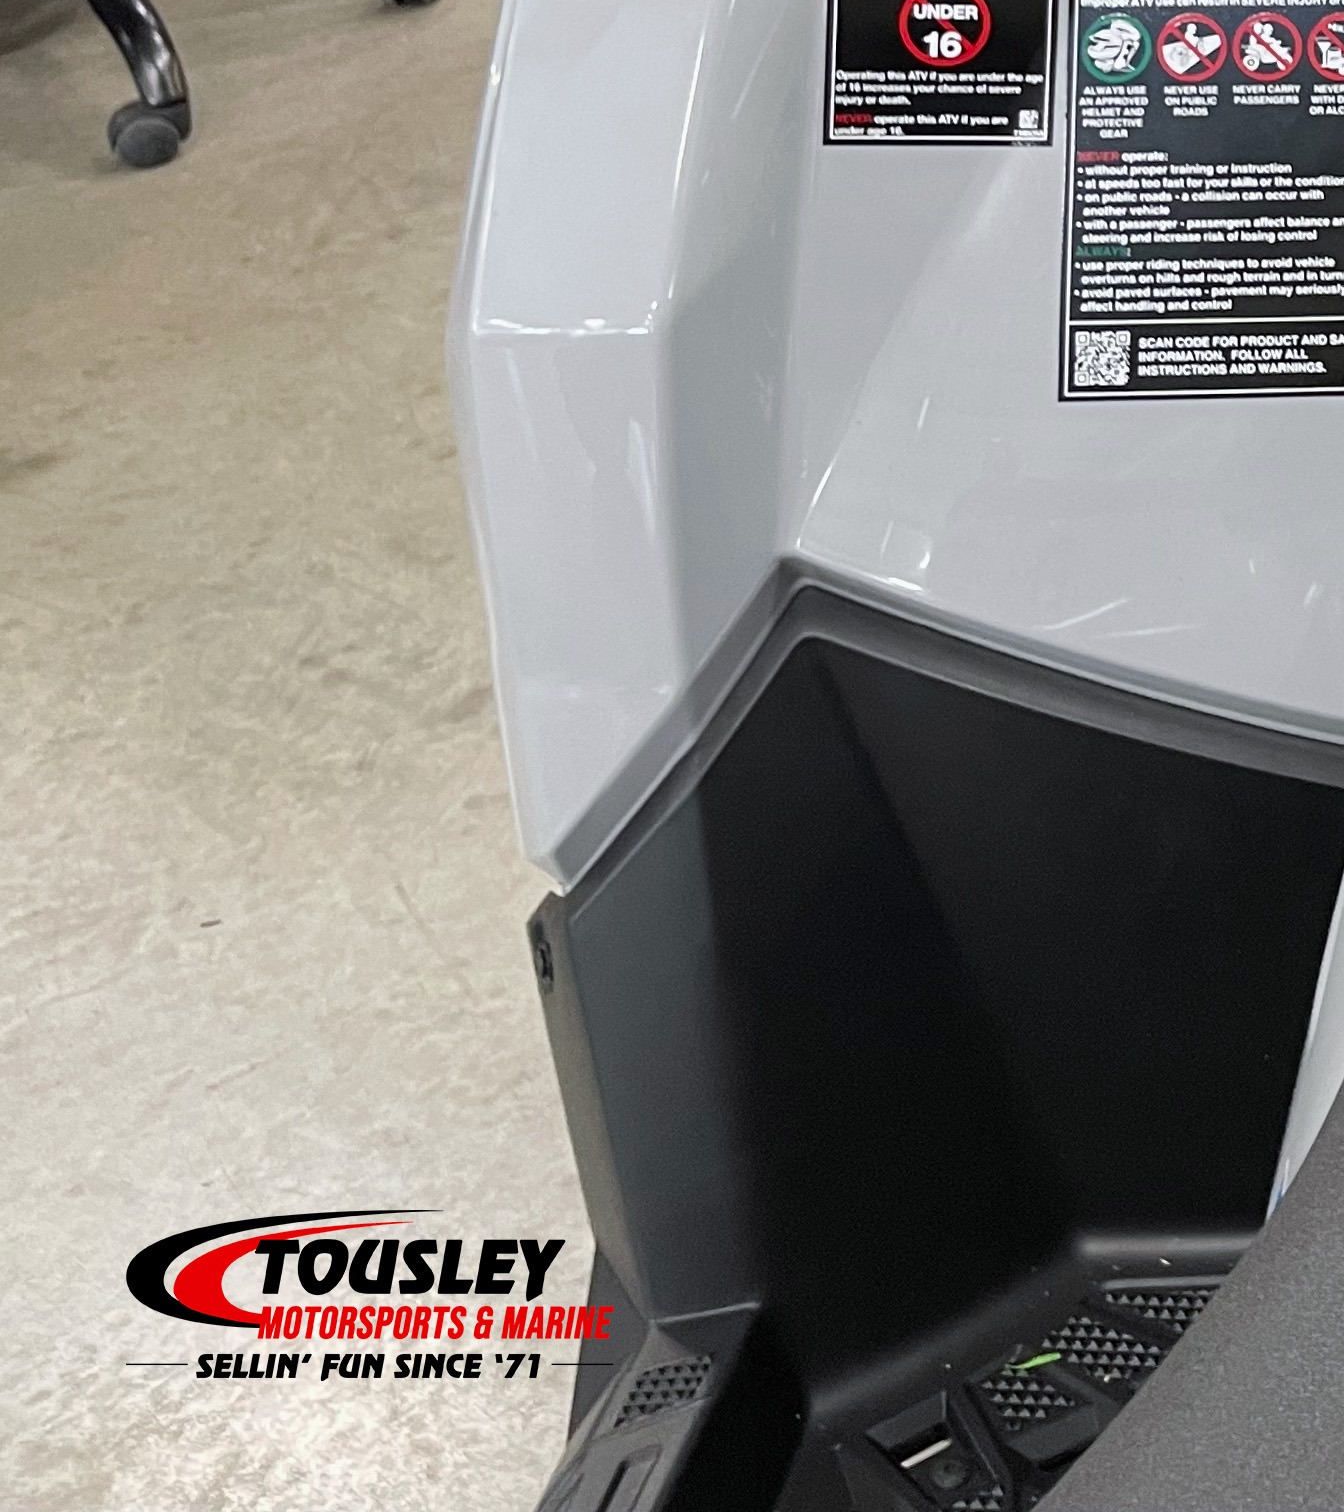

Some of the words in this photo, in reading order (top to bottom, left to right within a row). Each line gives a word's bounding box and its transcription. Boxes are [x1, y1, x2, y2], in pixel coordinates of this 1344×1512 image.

[912, 4, 979, 21] UNDER
[924, 31, 962, 59] 16
[1163, 85, 1197, 95] NEVER
[1198, 85, 1218, 95] USE
[1232, 84, 1265, 94] NEVER
[1266, 84, 1301, 94] CARRY
[1164, 96, 1180, 106] ON
[1180, 96, 1217, 106] PUBLIC
[1233, 95, 1299, 105] PASSENGERS
[1310, 95, 1335, 104] WITH
[1173, 107, 1208, 116] ROADS
[1308, 105, 1324, 115] OR
[1084, 164, 1128, 176] without
[1129, 165, 1168, 177] proper
[1169, 163, 1214, 177] training
[1215, 164, 1229, 174] or
[1230, 163, 1292, 174] instruction
[1084, 178, 1096, 190] at
[1097, 178, 1140, 190] speeds
[1140, 178, 1161, 189] too
[1161, 177, 1184, 188] fast
[1185, 177, 1203, 188] for
[1204, 178, 1229, 190] your
[1230, 176, 1258, 188] skills
[1258, 177, 1272, 188] or
[1273, 176, 1293, 187] the
[1084, 193, 1100, 203] on
[1101, 191, 1137, 204] public
[1138, 191, 1173, 202] roads
[1180, 192, 1189, 202] a
[1190, 190, 1240, 202] collision
[1241, 191, 1263, 201] can
[1264, 191, 1297, 201] occur
[1299, 189, 1324, 200] with
[1082, 205, 1127, 217] another
[1128, 204, 1170, 216] vehicle
[1083, 219, 1108, 230] with
[1108, 220, 1117, 230] a
[1118, 219, 1178, 231] passenger
[1185, 218, 1251, 230] passengers
[1252, 216, 1285, 228] affect
[1286, 216, 1330, 227] balance
[1082, 261, 1104, 271] use
[1105, 261, 1144, 272] proper
[1145, 259, 1180, 272] riding
[1181, 258, 1245, 270] techniques
[1246, 258, 1259, 269] to
[1260, 257, 1293, 268] avoid
[1294, 256, 1335, 268] vehicle
[1080, 301, 1113, 312] affect
[1114, 300, 1165, 313] handling
[1166, 299, 1189, 311] and
[1190, 299, 1232, 311] control
[1138, 337, 1173, 349] SCAN
[1174, 336, 1210, 348] CODE
[1211, 335, 1238, 348] FOR
[1239, 334, 1299, 347] PRODUCT
[1300, 334, 1327, 346] AND
[1138, 350, 1225, 362] INFORMATION.
[1230, 348, 1283, 361] FOLLOW
[1284, 348, 1308, 360] ALL
[1138, 363, 1227, 376] INSTRUCTIONS
[1228, 362, 1256, 374] AND
[1257, 361, 1326, 374] WARNINGS.
